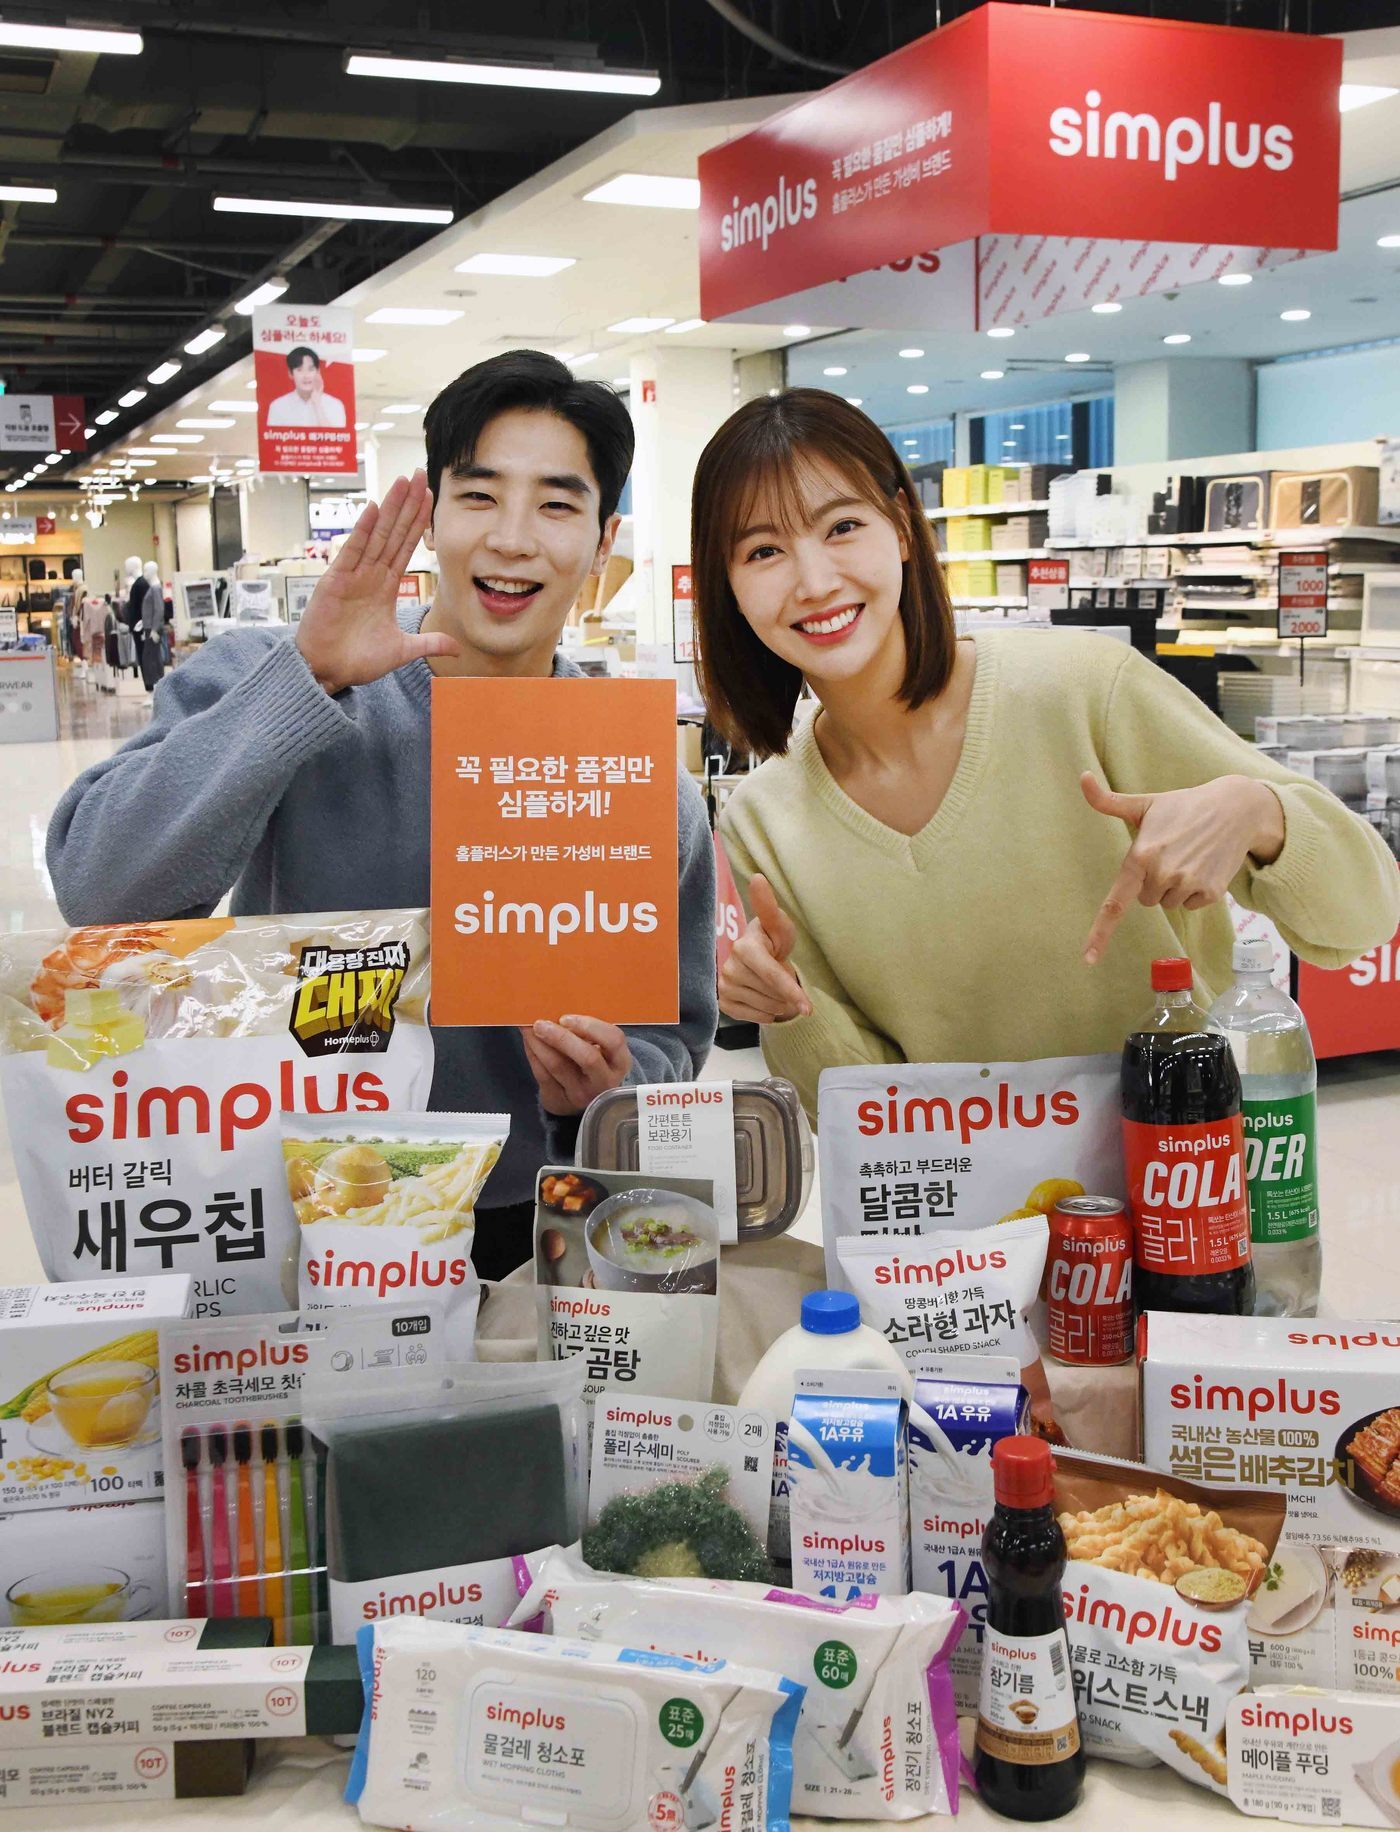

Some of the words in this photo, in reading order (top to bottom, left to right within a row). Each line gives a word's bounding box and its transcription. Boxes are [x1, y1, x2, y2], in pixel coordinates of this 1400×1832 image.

[905, 111, 952, 152] 심플하게!
[1049, 89, 1294, 180] simplus
[893, 160, 920, 188] 가성비
[922, 150, 951, 178] 브랜드
[721, 175, 818, 252] simplus
[286, 315, 321, 328] 오늘도
[261, 329, 306, 342] 심플러스
[309, 331, 346, 343] 하세요!
[263, 431, 306, 442] simplus
[1030, 566, 1067, 580] 추천상품
[455, 756, 483, 784] 꼭
[489, 755, 569, 784] 필요한
[574, 755, 655, 784] 품질만
[497, 790, 611, 818] 심플하게!
[455, 845, 527, 862] 홈플러스가
[530, 845, 558, 862] 만든
[562, 844, 606, 862] 가성비
[609, 844, 652, 862] 브랜드
[454, 890, 658, 945] simplus
[303, 950, 365, 972] 대용량
[366, 945, 407, 967] 진짜
[1350, 944, 1400, 987] si
[325, 1035, 370, 1047] Homeplus
[65, 1060, 390, 1152] simplus
[646, 1087, 723, 1109] simplus
[647, 1113, 692, 1127] 간편튼튼
[857, 1082, 1080, 1144] simplus
[648, 1127, 692, 1142] 보관용기
[1159, 1133, 1231, 1156] simplus
[69, 1163, 114, 1194] 버터
[123, 1158, 173, 1189] 갈릭
[859, 1162, 913, 1179] 촉촉하고
[916, 1157, 973, 1174] 부드러운
[1143, 1152, 1241, 1209] COLA
[860, 1180, 958, 1222] 달콤한
[1267, 1212, 1280, 1220] 1.5
[1282, 1211, 1288, 1219] L
[73, 1188, 267, 1273] 새우칩
[1142, 1214, 1198, 1264] 콜라
[1062, 1236, 1127, 1257] simplus
[1209, 1239, 1222, 1248] 1.5
[1223, 1237, 1229, 1245] L
[307, 1250, 467, 1298] simplus
[874, 1249, 1008, 1287] simplus
[1051, 1258, 1133, 1306] COLA
[962, 1286, 985, 1302] 가득
[76, 1303, 145, 1313] simplus
[550, 1296, 611, 1318] simplus
[395, 1319, 427, 1335] 10개입
[883, 1309, 958, 1344] 소라형
[964, 1299, 1017, 1335] 과자
[1050, 1307, 1096, 1358] 콜라
[551, 1321, 581, 1340] 진하고
[584, 1324, 612, 1343] 깊은
[615, 1327, 630, 1345] 맛
[938, 1343, 971, 1354] SHAPED
[972, 1338, 1002, 1350] SNACK
[174, 1339, 309, 1376] simplus
[176, 1381, 207, 1399] 차콜
[212, 1376, 276, 1395] 초극세모
[943, 1385, 990, 1397] simplus
[1170, 1374, 1341, 1422] simplus
[176, 1400, 222, 1409] CHARCOAL
[224, 1392, 289, 1404] TOOTHBRUSHES
[606, 1407, 672, 1427] simplus
[936, 1404, 958, 1420] 1A
[960, 1405, 991, 1422] 우유
[744, 1424, 762, 1438] 2매
[1171, 1424, 1222, 1444] 국내산
[1225, 1427, 1276, 1446] 농산물
[1281, 1431, 1317, 1447] 100%
[604, 1438, 631, 1456] 폴리
[633, 1441, 674, 1460] 수세미
[1169, 1445, 1236, 1483] 썰은
[1239, 1455, 1355, 1489] 배추김치
[91, 1476, 124, 1493] 100
[1288, 1494, 1316, 1503] IMCHI
[803, 1532, 885, 1554] simplus
[923, 1543, 946, 1555] 국내산
[804, 1558, 825, 1567] 국내산
[871, 1562, 886, 1571] 만든
[814, 1570, 877, 1585] 저지방고칼슘
[362, 1582, 483, 1618] simplus
[1062, 1584, 1223, 1653] simplus
[170, 1630, 191, 1638] 10T
[823, 1648, 850, 1666] 표준
[991, 1641, 1037, 1661] simplus
[1270, 1643, 1285, 1652] 600
[1353, 1649, 1375, 1661] 1등급
[51, 1664, 90, 1674] 브라질
[93, 1664, 121, 1672] NY2
[276, 1659, 297, 1667] 10T
[1105, 1653, 1145, 1677] 고소함
[1148, 1663, 1178, 1685] 가득
[1354, 1663, 1394, 1680] 100%
[90, 1671, 142, 1682] 캡슐커피
[370, 1646, 386, 1720] simplus
[416, 1668, 437, 1681] 120
[990, 1666, 1034, 1694] 참기름
[271, 1695, 295, 1707] 10T
[1073, 1669, 1211, 1733] 위스트스낵
[0, 1705, 30, 1720] us
[41, 1708, 82, 1721] 브라질
[86, 1708, 114, 1720] NY2
[486, 1701, 566, 1730] simplus
[668, 1705, 695, 1723] 표준
[906, 1701, 922, 1745] 청소포
[1088, 1715, 1121, 1732] SNACK
[1241, 1703, 1353, 1737] simplus
[42, 1723, 82, 1737] 블렌드
[87, 1721, 140, 1735] 캡슐커피
[483, 1733, 531, 1760] 물걸레
[537, 1741, 587, 1768] 청소포
[880, 1715, 895, 1801] simplus
[140, 1757, 163, 1769] 10T
[482, 1759, 498, 1768] WET
[741, 1739, 757, 1787] 청소포
[904, 1750, 922, 1792] 정전기
[1241, 1748, 1292, 1773] 메이플
[1295, 1752, 1329, 1776] 푸딩
[804, 1783, 820, 1792] SIZE
